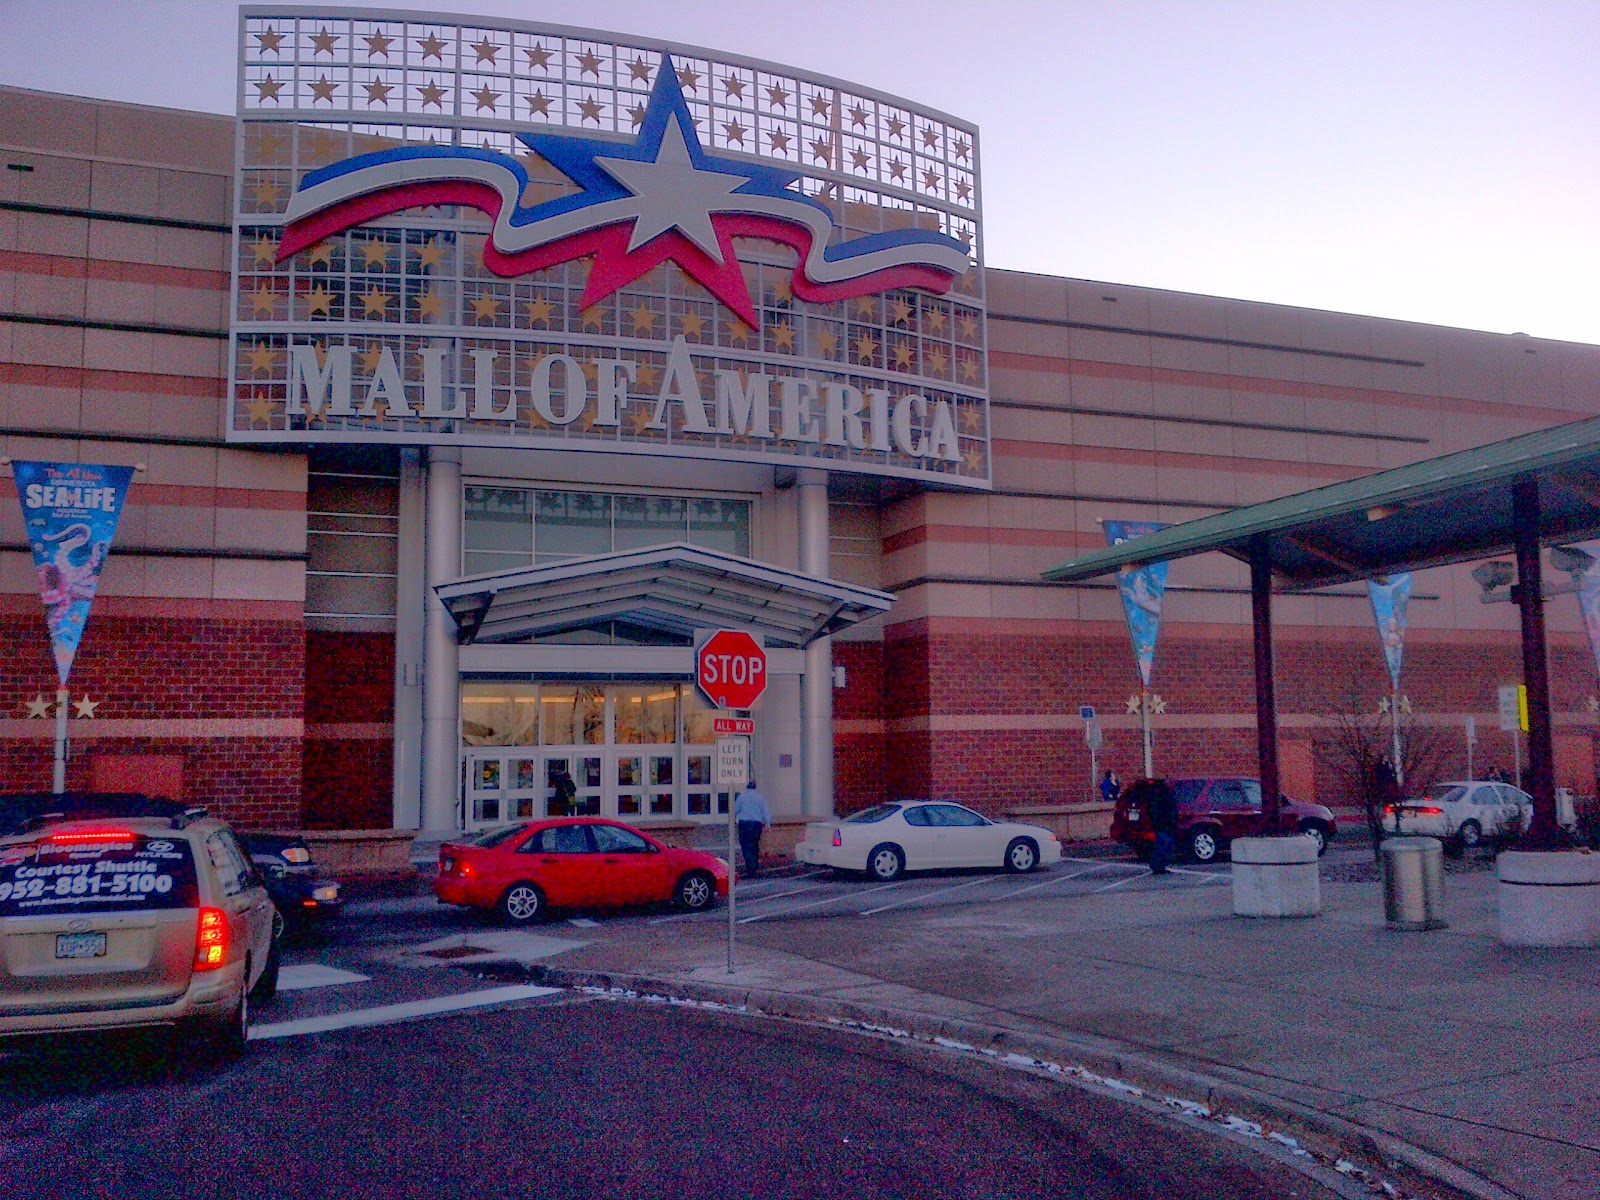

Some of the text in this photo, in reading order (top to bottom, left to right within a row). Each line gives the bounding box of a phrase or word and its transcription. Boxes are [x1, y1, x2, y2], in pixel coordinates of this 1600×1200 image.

[286, 334, 965, 463] MALL OF AMERICA
[26, 483, 69, 509] SEA
[703, 653, 763, 686] STOP
[716, 721, 752, 732] ALL WAY
[722, 744, 742, 754] LEFT
[721, 757, 744, 766] TURN
[720, 769, 744, 779] ONLY
[38, 842, 134, 856] Bloomington
[15, 859, 158, 879] Courtesy Shuttle
[0, 873, 173, 901] 952-881-5100
